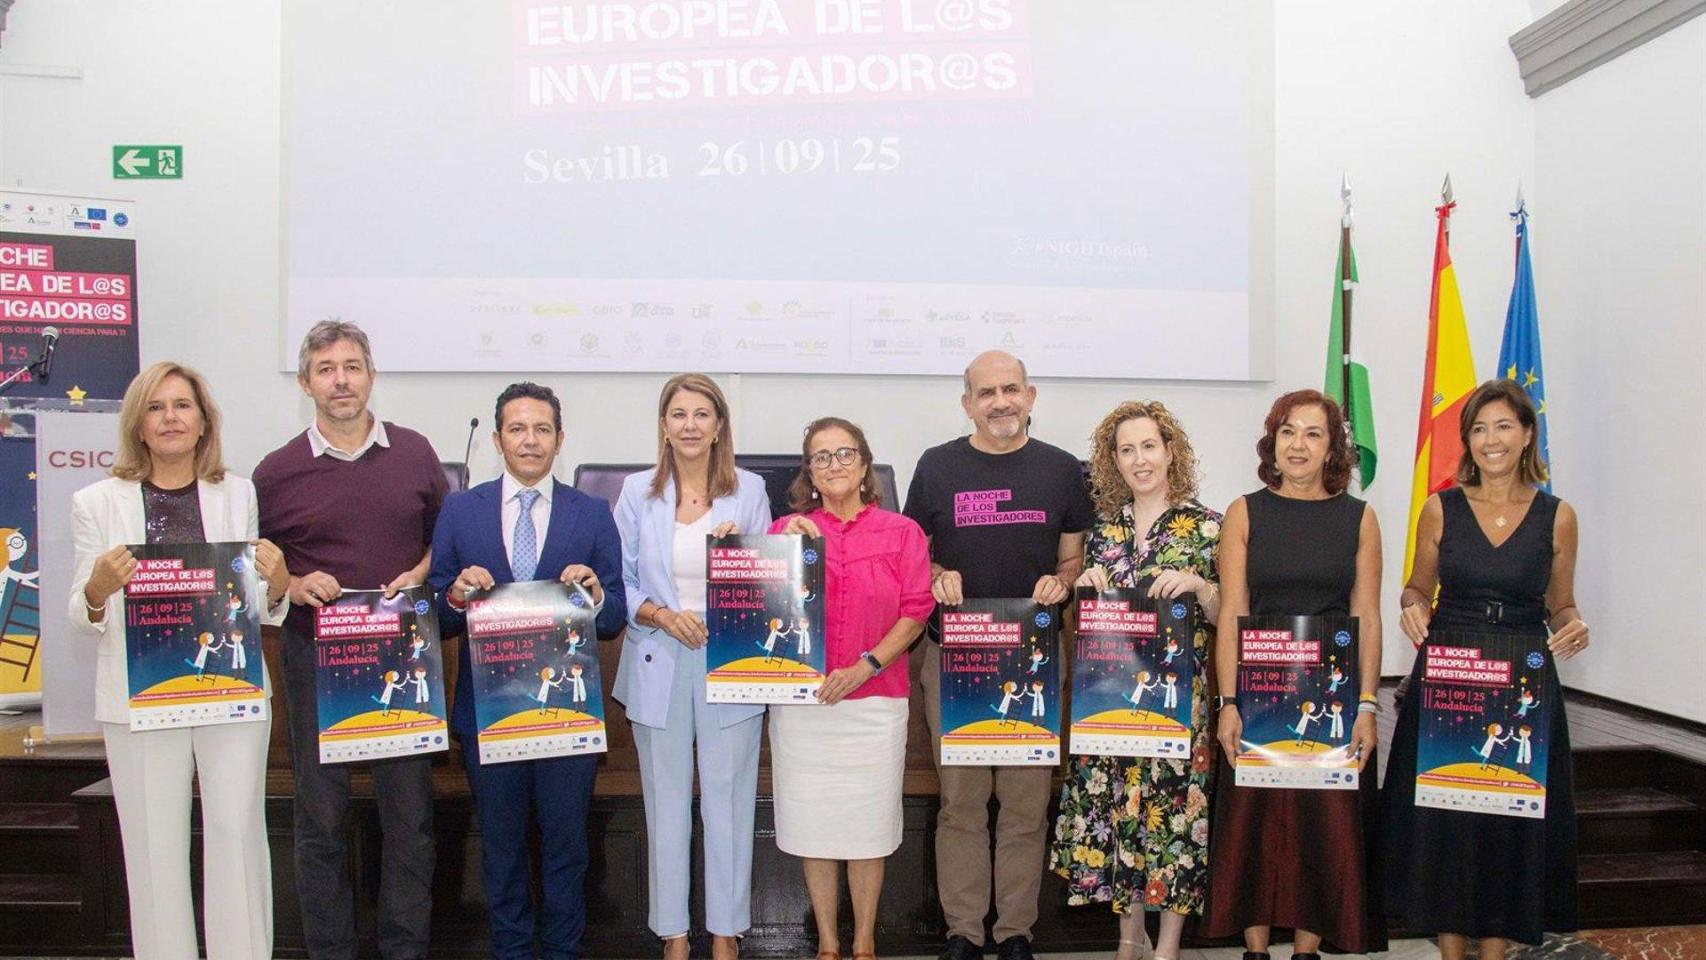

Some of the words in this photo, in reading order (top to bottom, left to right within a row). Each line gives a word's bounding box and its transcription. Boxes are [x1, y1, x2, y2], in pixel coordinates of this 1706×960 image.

[528, 0, 789, 45] EUROPEA
[816, 0, 883, 34] DE
[902, 0, 1012, 32] L@S
[528, 52, 1017, 105] INVESTIGADOR@S
[523, 146, 669, 183] Sevilla
[698, 141, 748, 176] 26
[775, 138, 825, 174] 09
[852, 137, 901, 171] 25
[42, 275, 73, 294] DE
[79, 277, 126, 295] L@S
[8, 346, 28, 361] 25
[49, 450, 115, 468] CSIC
[957, 493, 970, 502] LA
[973, 491, 1009, 500] NOCHE
[957, 504, 970, 513] DE
[972, 503, 994, 512] LOS
[957, 512, 1045, 525] INVESTIGADORES
[712, 550, 723, 558] LA
[148, 560, 182, 569] NOCHE
[712, 560, 752, 568] EUROPEA
[179, 571, 191, 580] DE
[131, 581, 214, 592] INVESTIGADOR@S
[320, 607, 333, 615] LA
[337, 606, 369, 615] NOCHE
[1081, 601, 1094, 609] LA
[1097, 602, 1128, 610] NOCHE
[320, 616, 362, 625] EUROPEA
[945, 614, 957, 622] LA
[961, 614, 991, 622] NOCHE
[1081, 611, 1121, 620] EUROPEA
[1124, 613, 1134, 621] DE
[320, 624, 398, 635] INVESTIGADOR@S
[945, 624, 984, 632] EUROPEA
[988, 624, 999, 632] DE
[1080, 621, 1154, 632] INVESTIGADOR@S
[945, 634, 1018, 642] INVESTIGADOR@S
[1243, 632, 1255, 640] LA
[1259, 632, 1289, 640] NOCHE
[1243, 642, 1283, 650] EUROPEA
[1286, 642, 1298, 650] DE
[1243, 652, 1317, 661] INVESTIGADOR@S
[1428, 647, 1441, 656] LA
[1445, 648, 1478, 658] NOCHE
[1428, 658, 1471, 668] EUROPEA
[1474, 661, 1486, 670] DE
[1427, 668, 1508, 682] INVESTIGADOR@S
